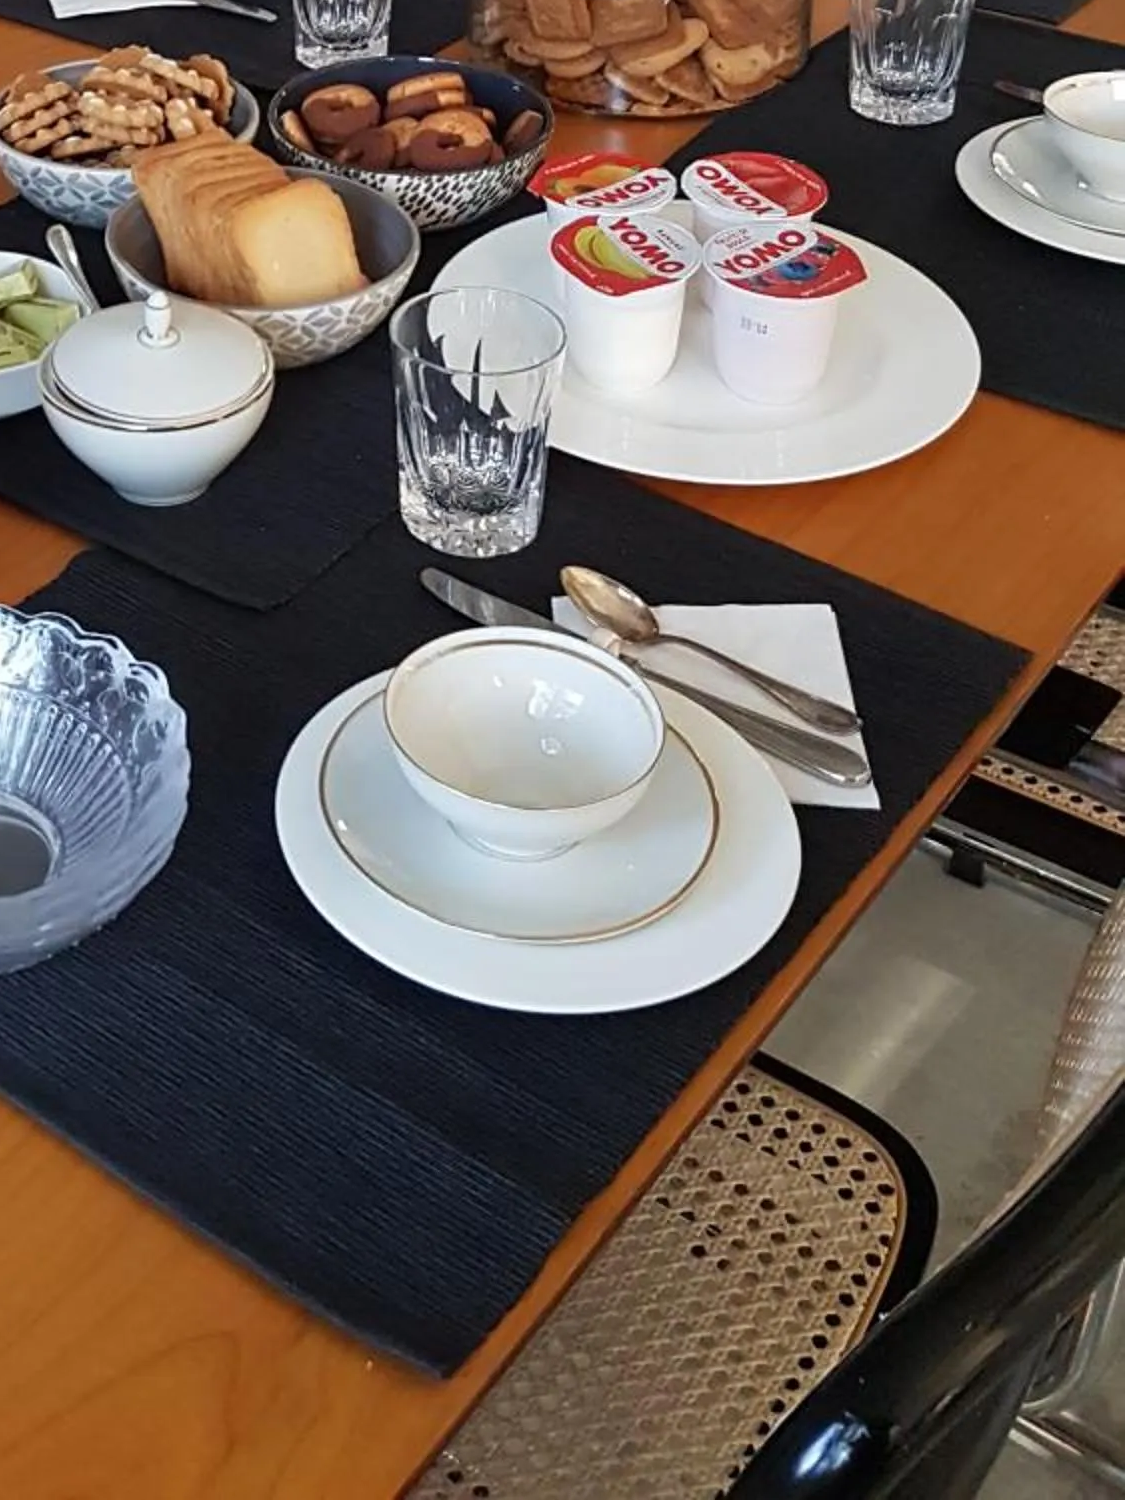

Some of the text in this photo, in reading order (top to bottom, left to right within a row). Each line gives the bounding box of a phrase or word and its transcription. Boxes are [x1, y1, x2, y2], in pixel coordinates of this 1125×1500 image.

[577, 175, 669, 207] YOMO
[696, 165, 774, 215] YOMO
[609, 217, 686, 274] YOMO
[713, 230, 806, 275] YOMO
